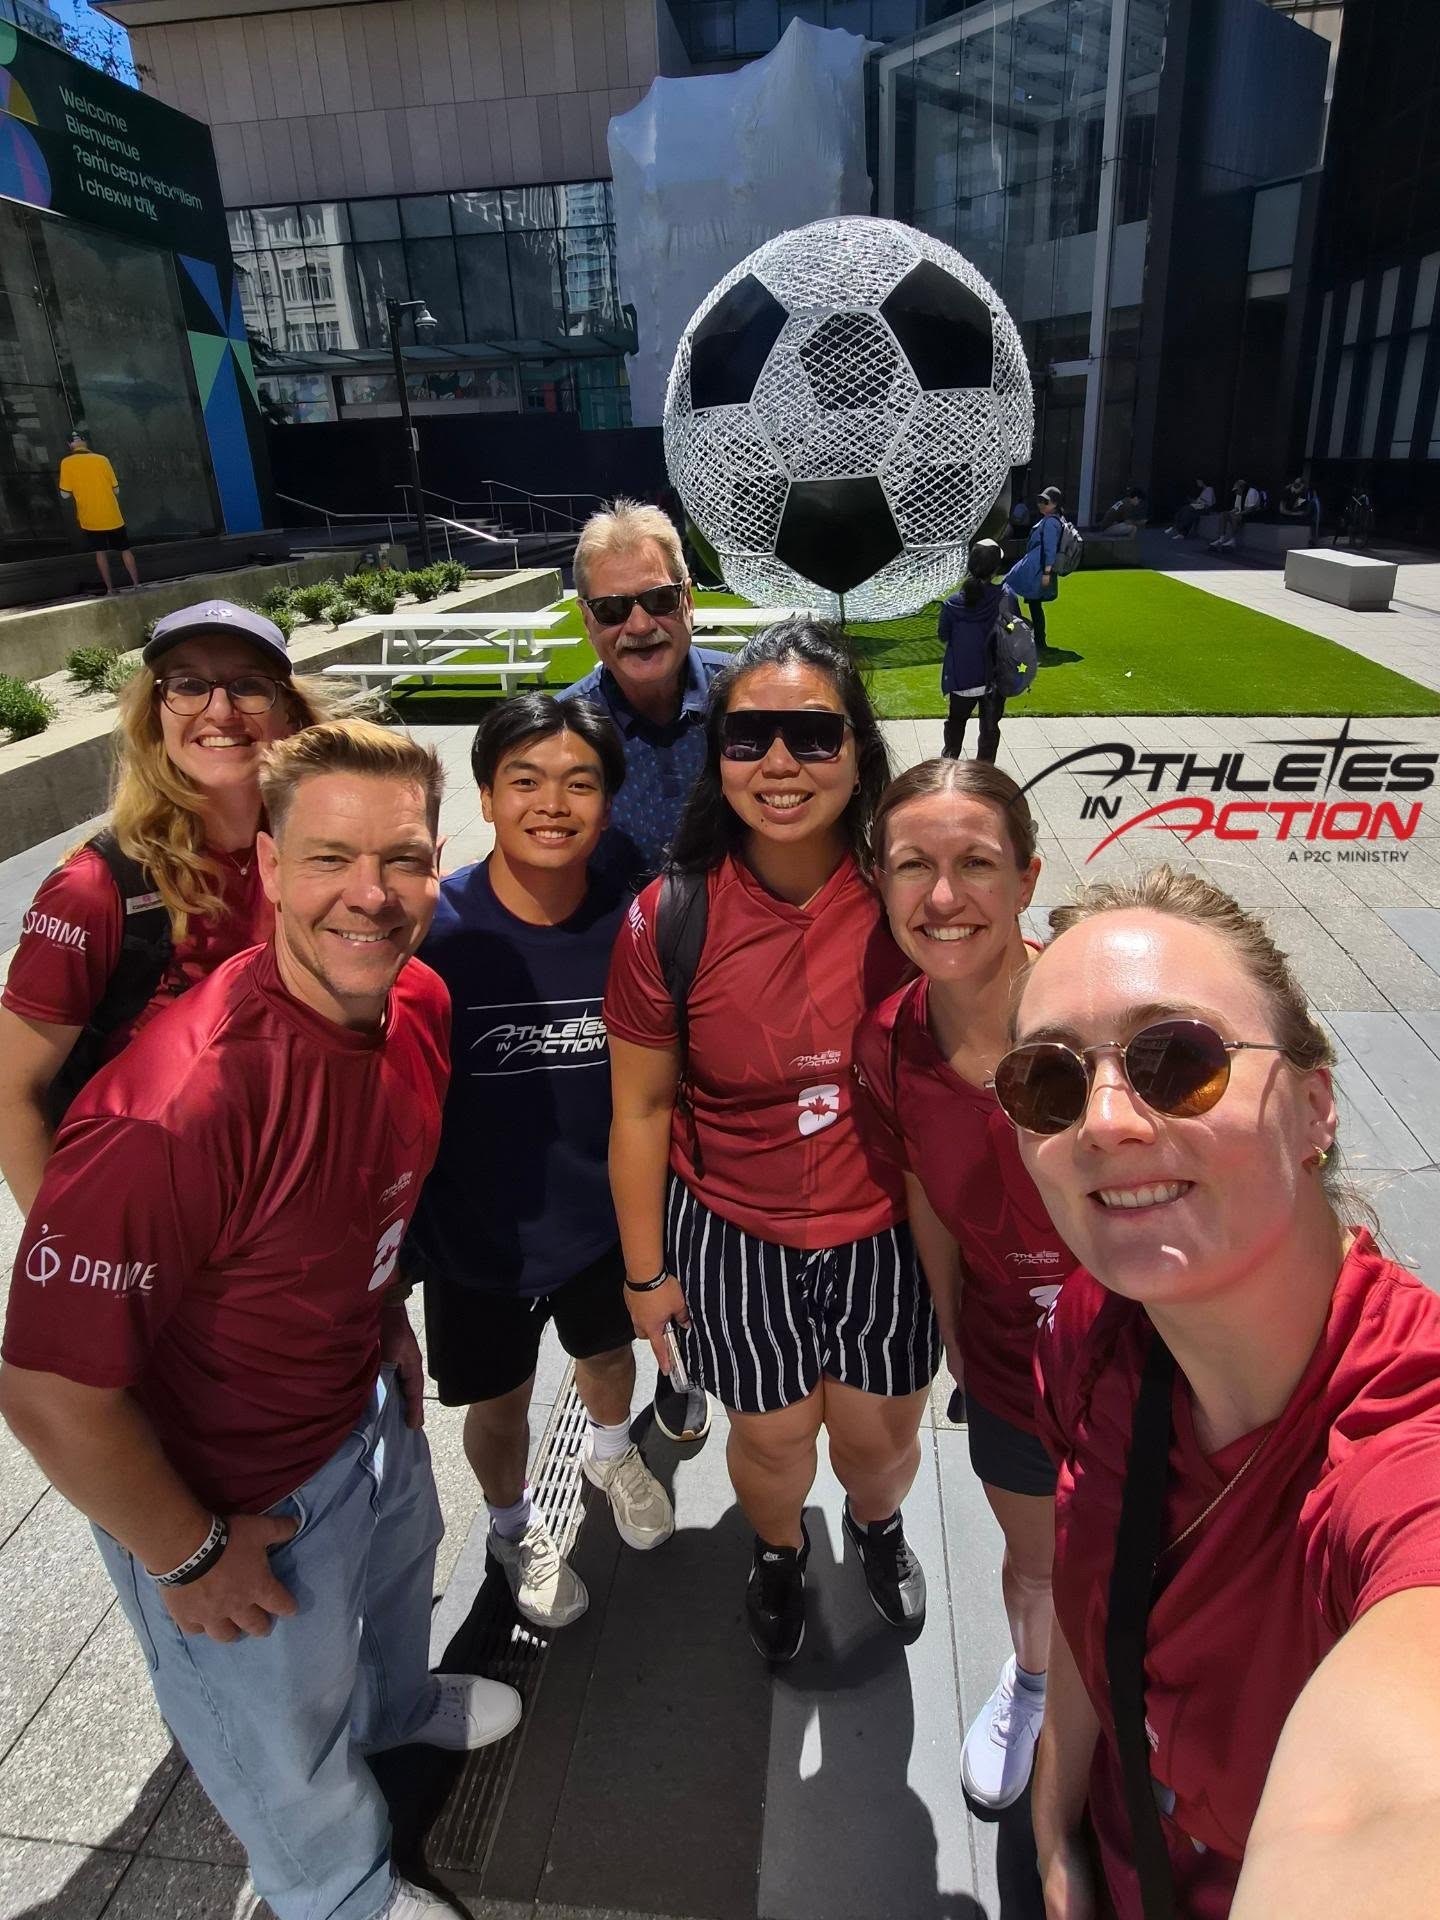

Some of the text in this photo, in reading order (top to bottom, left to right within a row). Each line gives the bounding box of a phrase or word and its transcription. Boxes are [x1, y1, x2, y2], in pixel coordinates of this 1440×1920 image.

[59, 86, 128, 133] Welcome
[65, 114, 140, 161] Bienvenue
[86, 180, 132, 208] chexw
[496, 1036, 606, 1067] IN ACTION
[69, 1254, 159, 1291] DRIME
